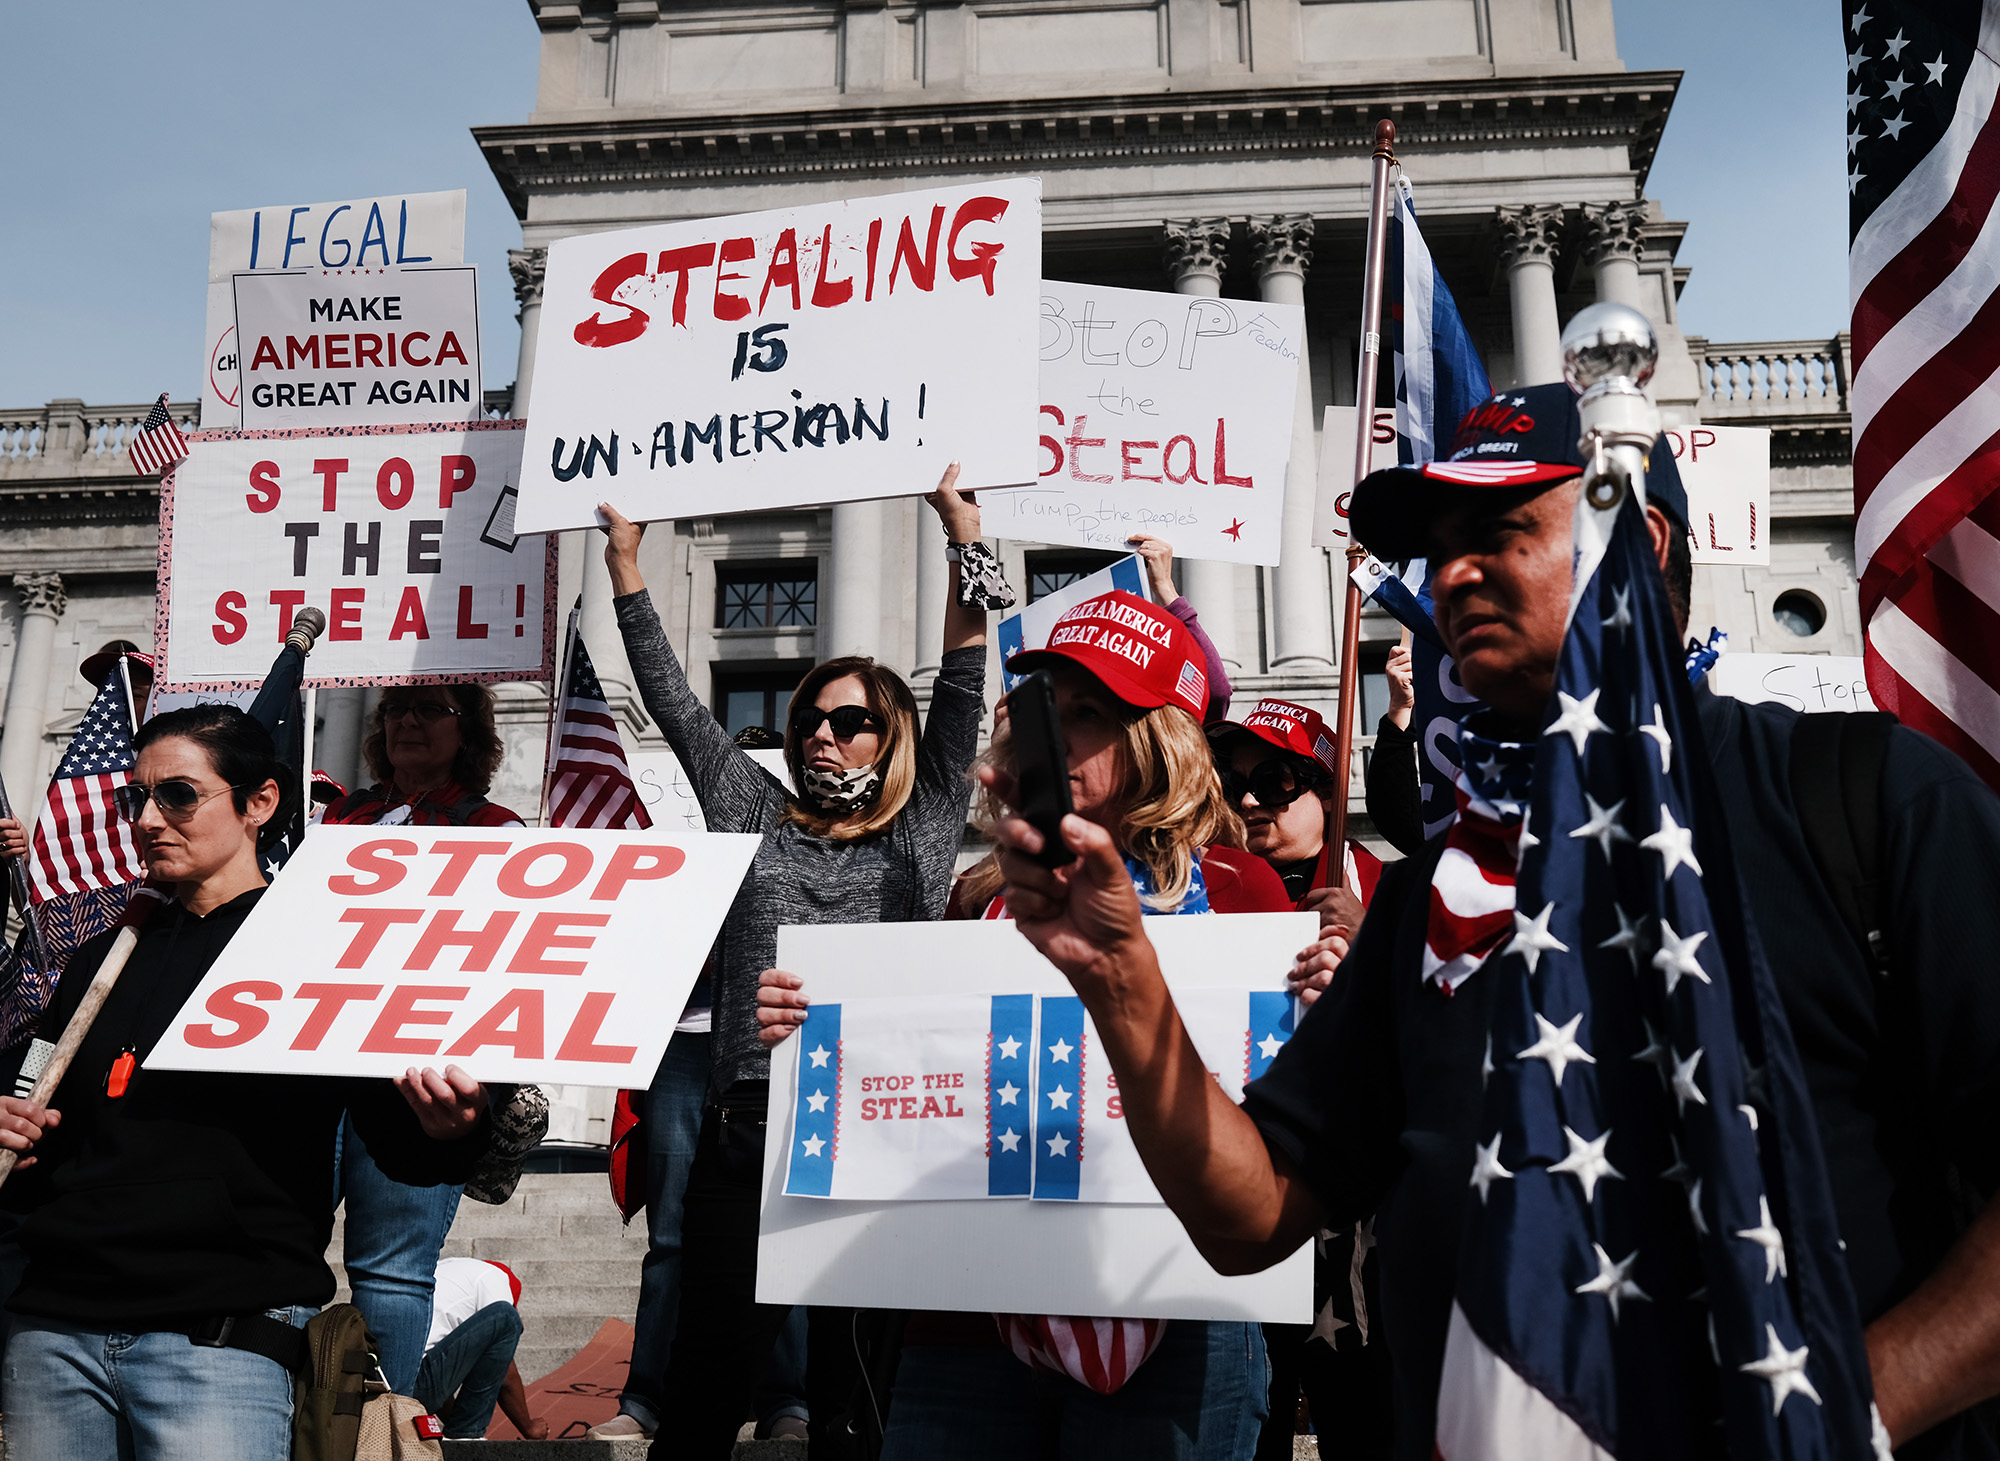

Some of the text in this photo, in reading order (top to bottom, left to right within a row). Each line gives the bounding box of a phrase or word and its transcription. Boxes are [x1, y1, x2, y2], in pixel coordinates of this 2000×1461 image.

[573, 197, 1010, 348] STEALING
[309, 297, 402, 322] MAKE
[250, 330, 469, 371] AMERICA
[732, 323, 789, 381] IS
[252, 379, 470, 407] GREAT AGAIN
[1088, 378, 1159, 415] the
[246, 455, 477, 513] STOP
[1095, 499, 1132, 521] the
[285, 520, 444, 576] THE
[212, 584, 526, 645] STEAL!
[1058, 600, 1173, 649] MAKE AMERICA
[1052, 625, 1156, 669] GREAT AGAIN
[1762, 665, 1868, 713] Stop
[1250, 716, 1295, 734] AGAIN
[327, 838, 686, 901] STOP
[335, 908, 611, 975] THE
[183, 980, 639, 1064] STEAL
[861, 1073, 964, 1092] STOP THE
[860, 1095, 963, 1121] STEAL
